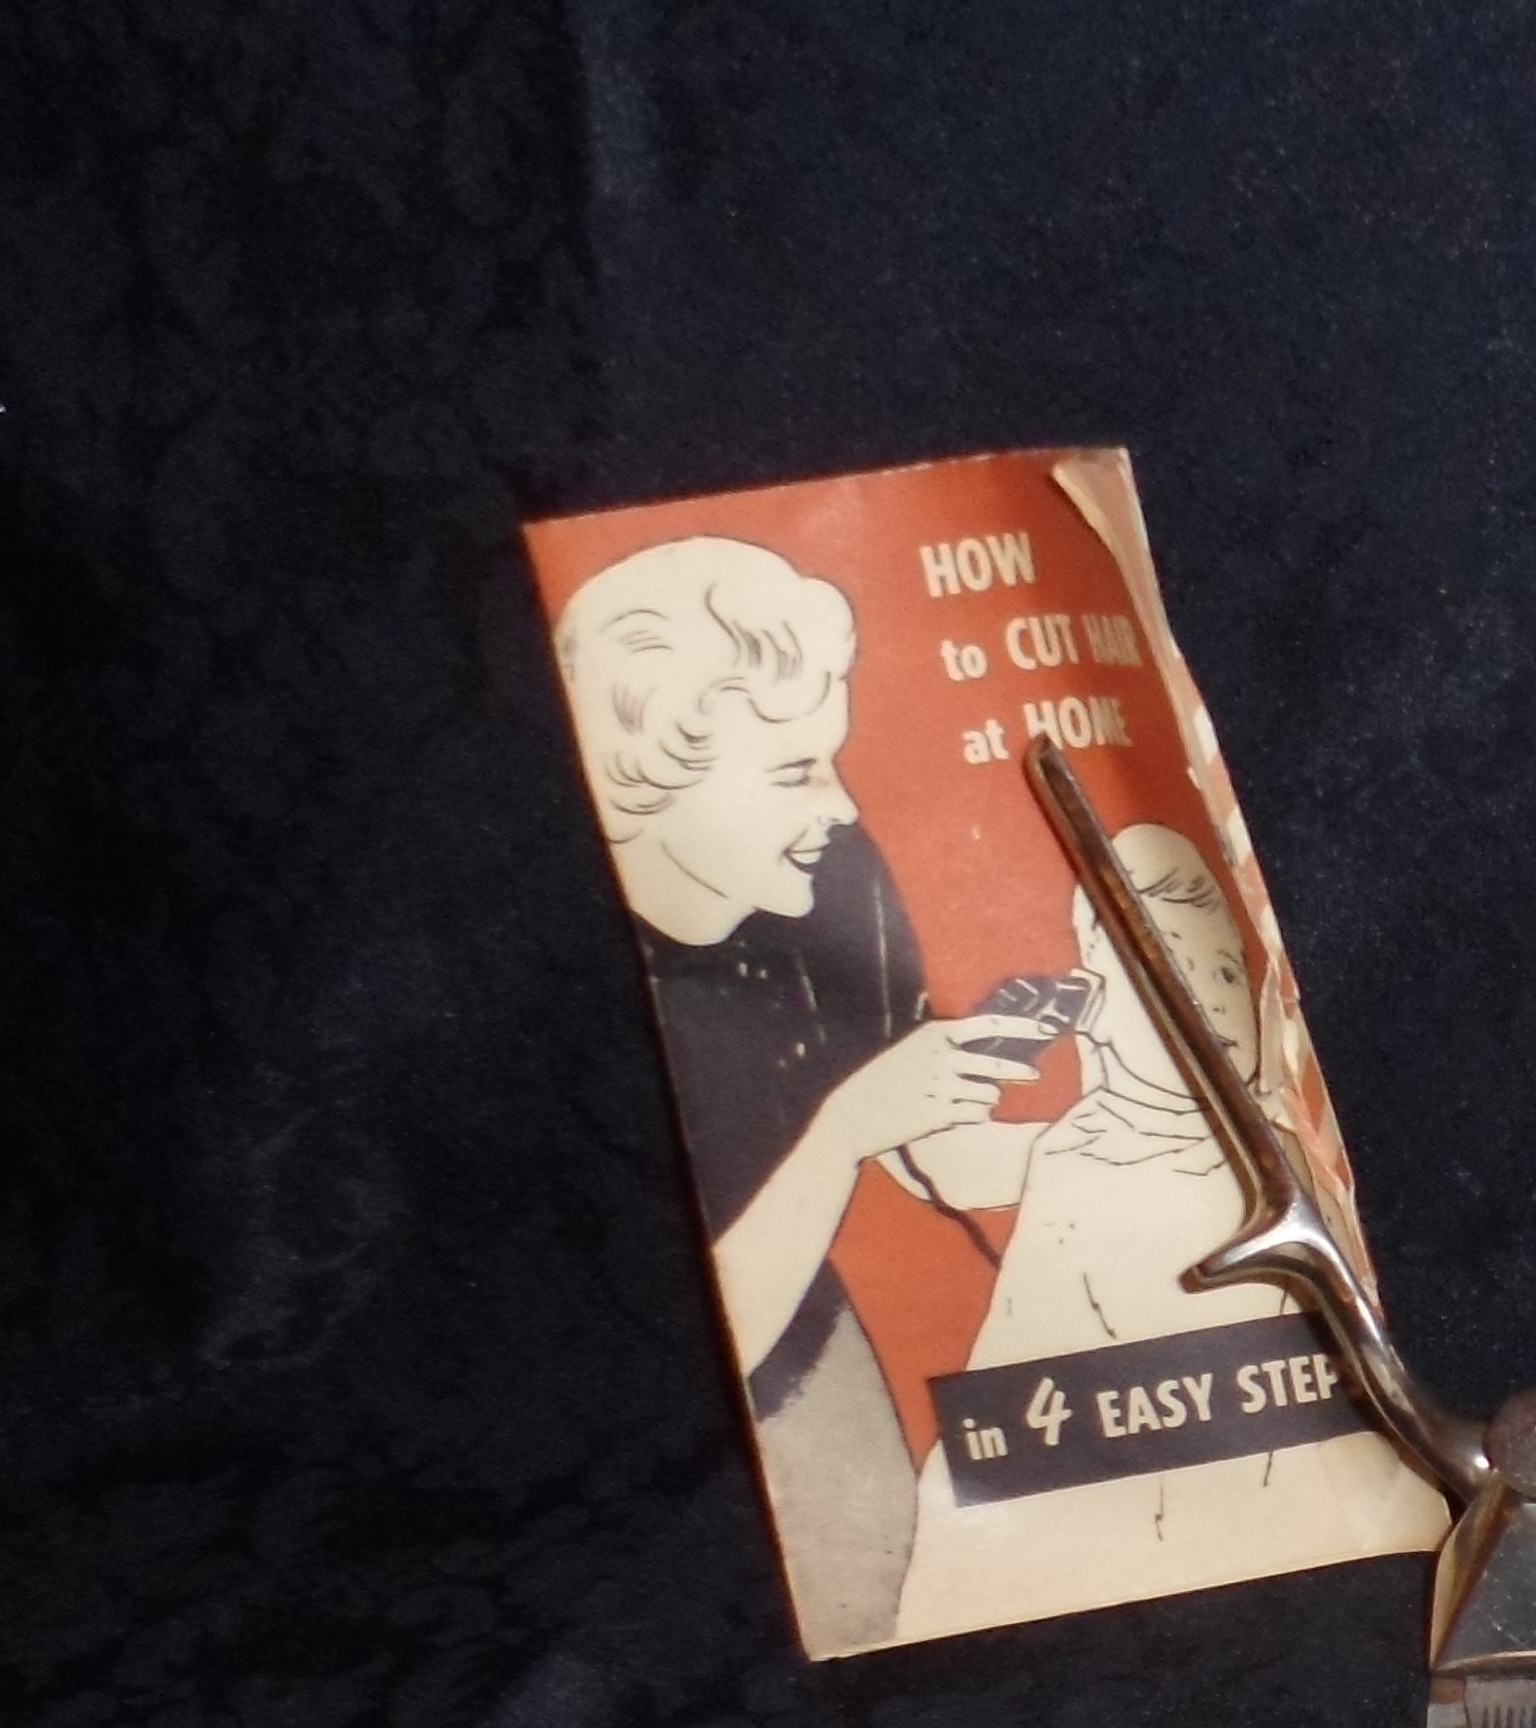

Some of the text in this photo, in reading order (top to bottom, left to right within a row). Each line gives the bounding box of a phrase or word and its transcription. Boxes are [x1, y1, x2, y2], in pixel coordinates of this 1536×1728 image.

[920, 532, 1035, 598] HOW
[940, 639, 987, 681] to
[1005, 614, 1078, 670] CUT
[962, 719, 1008, 765] at
[962, 1354, 1342, 1460] in 4 EASY STEP
